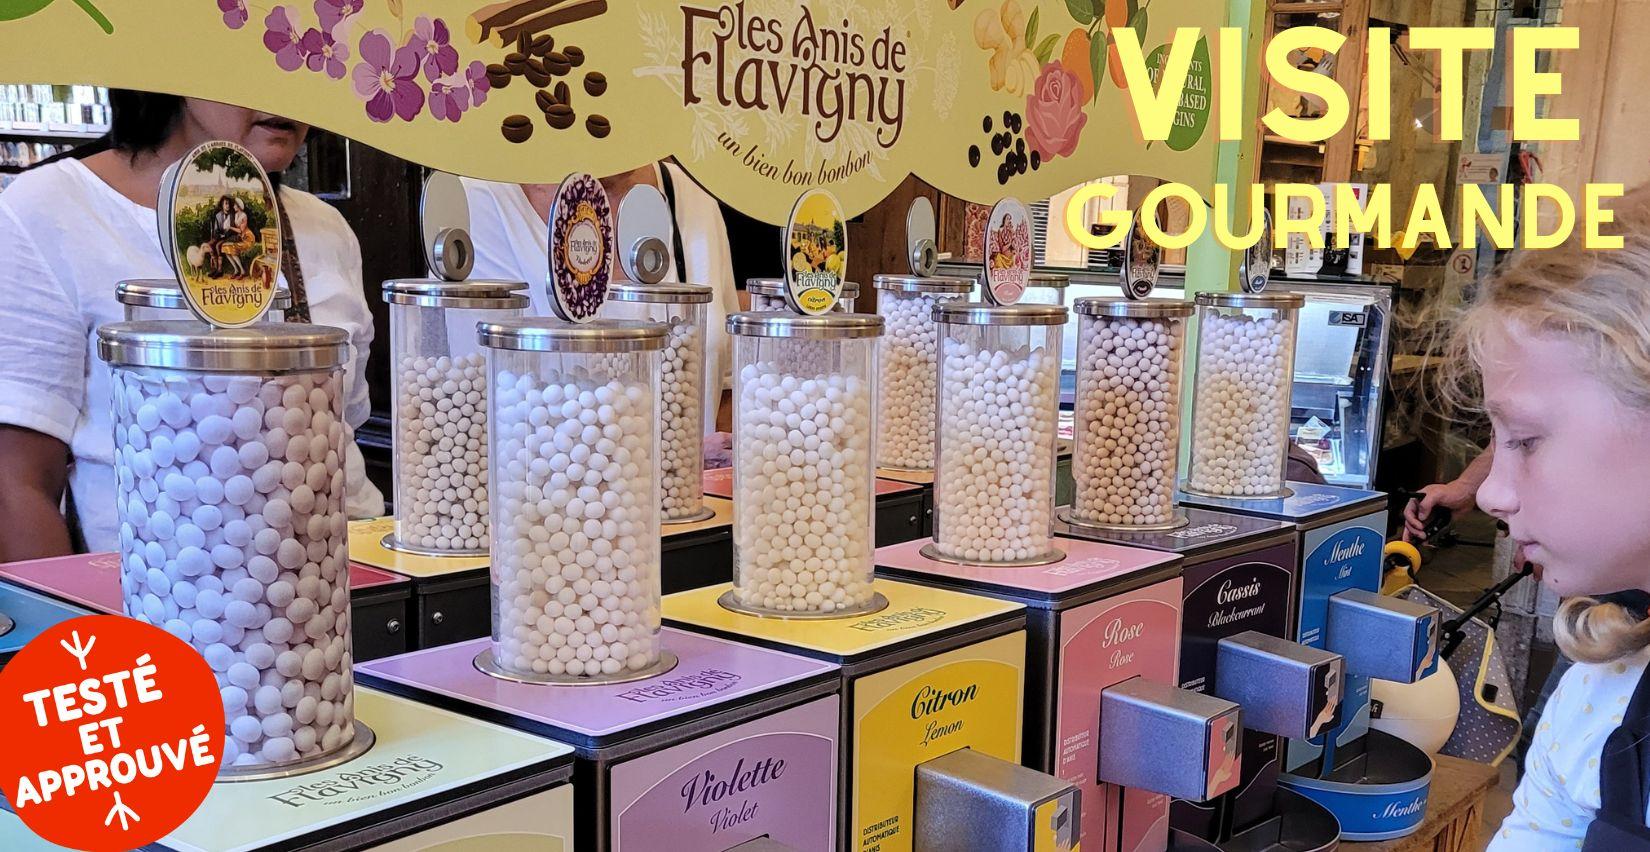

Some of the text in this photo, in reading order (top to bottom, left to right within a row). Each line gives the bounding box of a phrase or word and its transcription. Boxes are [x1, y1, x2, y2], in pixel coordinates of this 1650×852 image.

[735, 0, 906, 73] les Anis de
[680, 5, 905, 148] Flavigny
[717, 132, 873, 186] un bien bon bonbon
[202, 287, 263, 308] Flavigny
[213, 283, 262, 294] les Anis de
[1324, 536, 1365, 565] Menthe
[1217, 577, 1261, 605] Cassis
[1207, 602, 1265, 628] Blackcurrant
[1102, 617, 1144, 649] Rose
[1109, 649, 1134, 669] Rose
[911, 684, 980, 719] Citron
[920, 720, 964, 747] Lemon
[266, 757, 444, 808] Flavigny
[681, 757, 787, 813] Violette
[710, 800, 758, 834] Violet
[1372, 797, 1421, 819] Menthe
